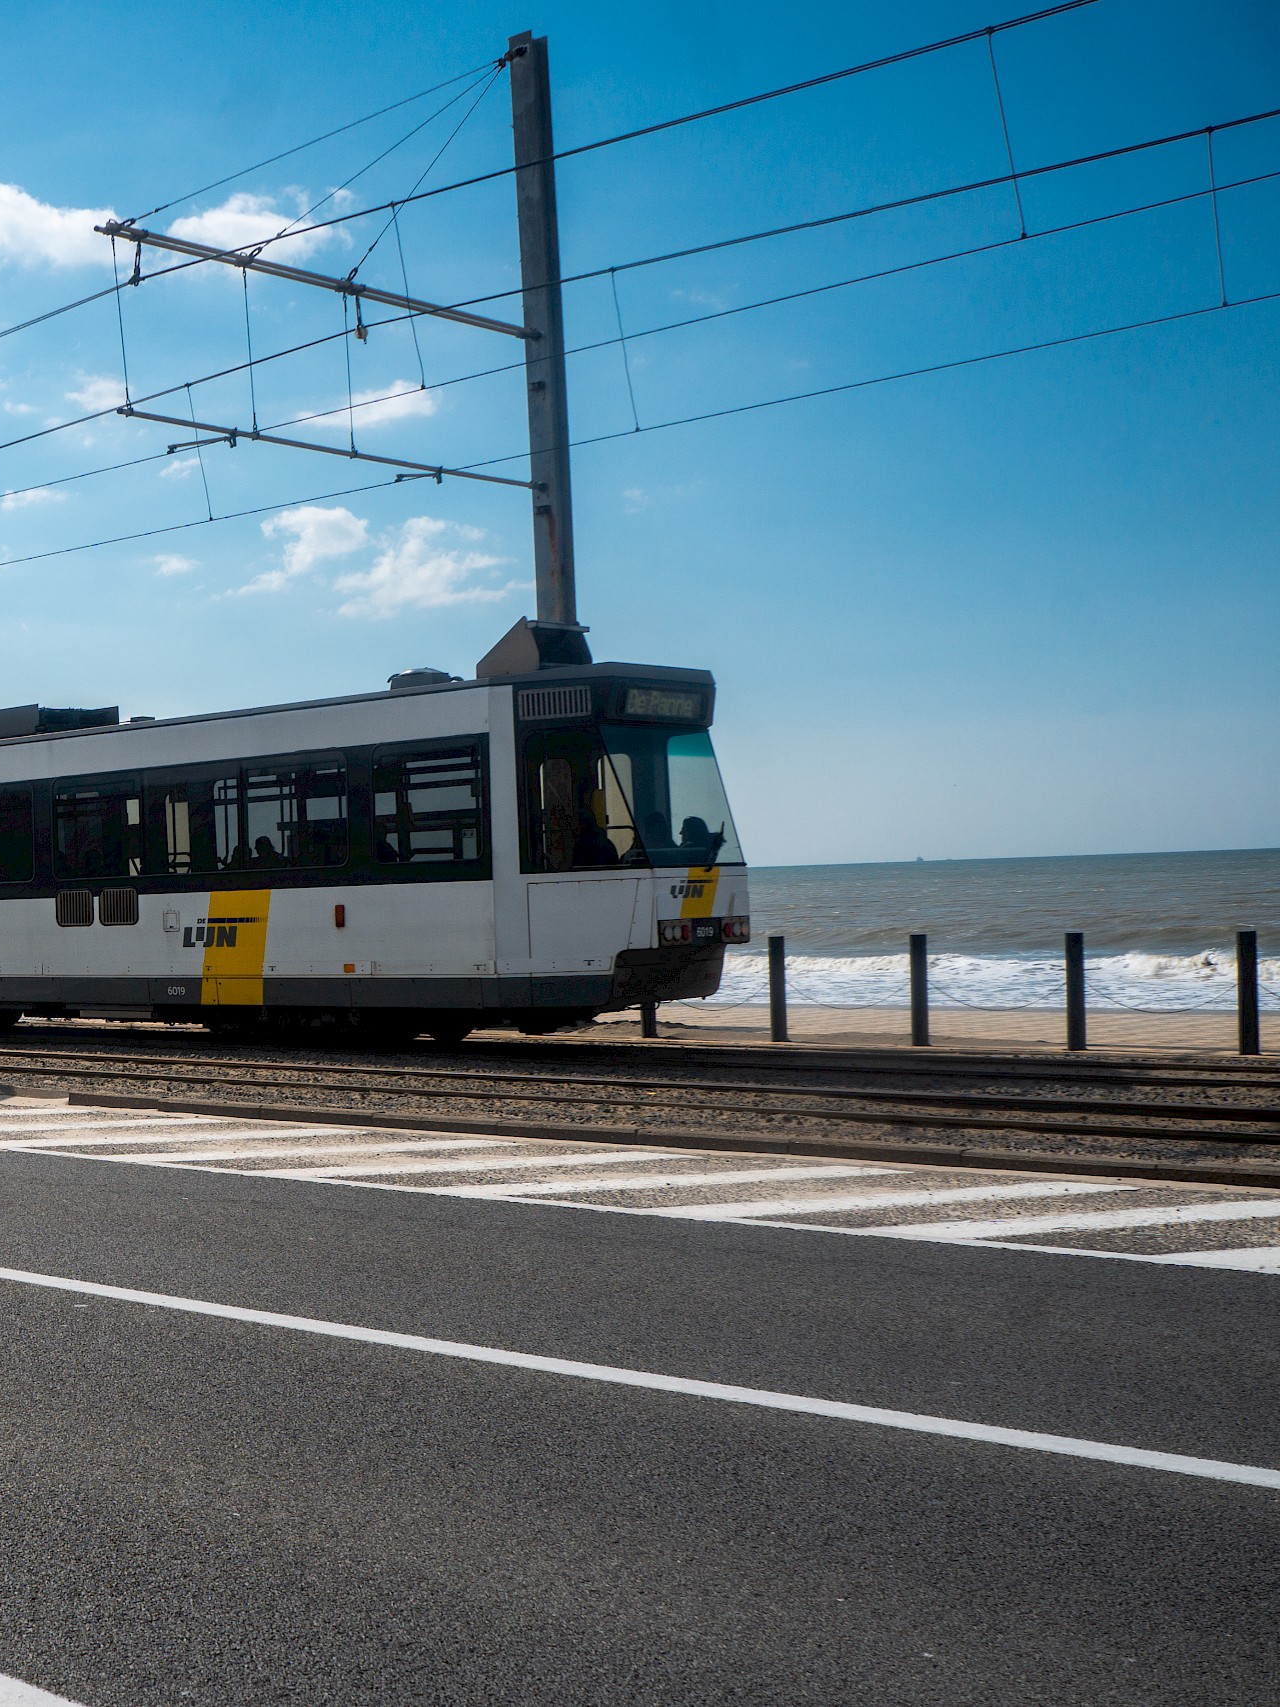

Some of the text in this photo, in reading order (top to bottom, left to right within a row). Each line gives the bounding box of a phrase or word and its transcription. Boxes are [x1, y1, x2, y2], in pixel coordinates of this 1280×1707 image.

[626, 689, 692, 717] De Panne
[696, 926, 714, 937] 6019
[167, 986, 186, 996] 6019
